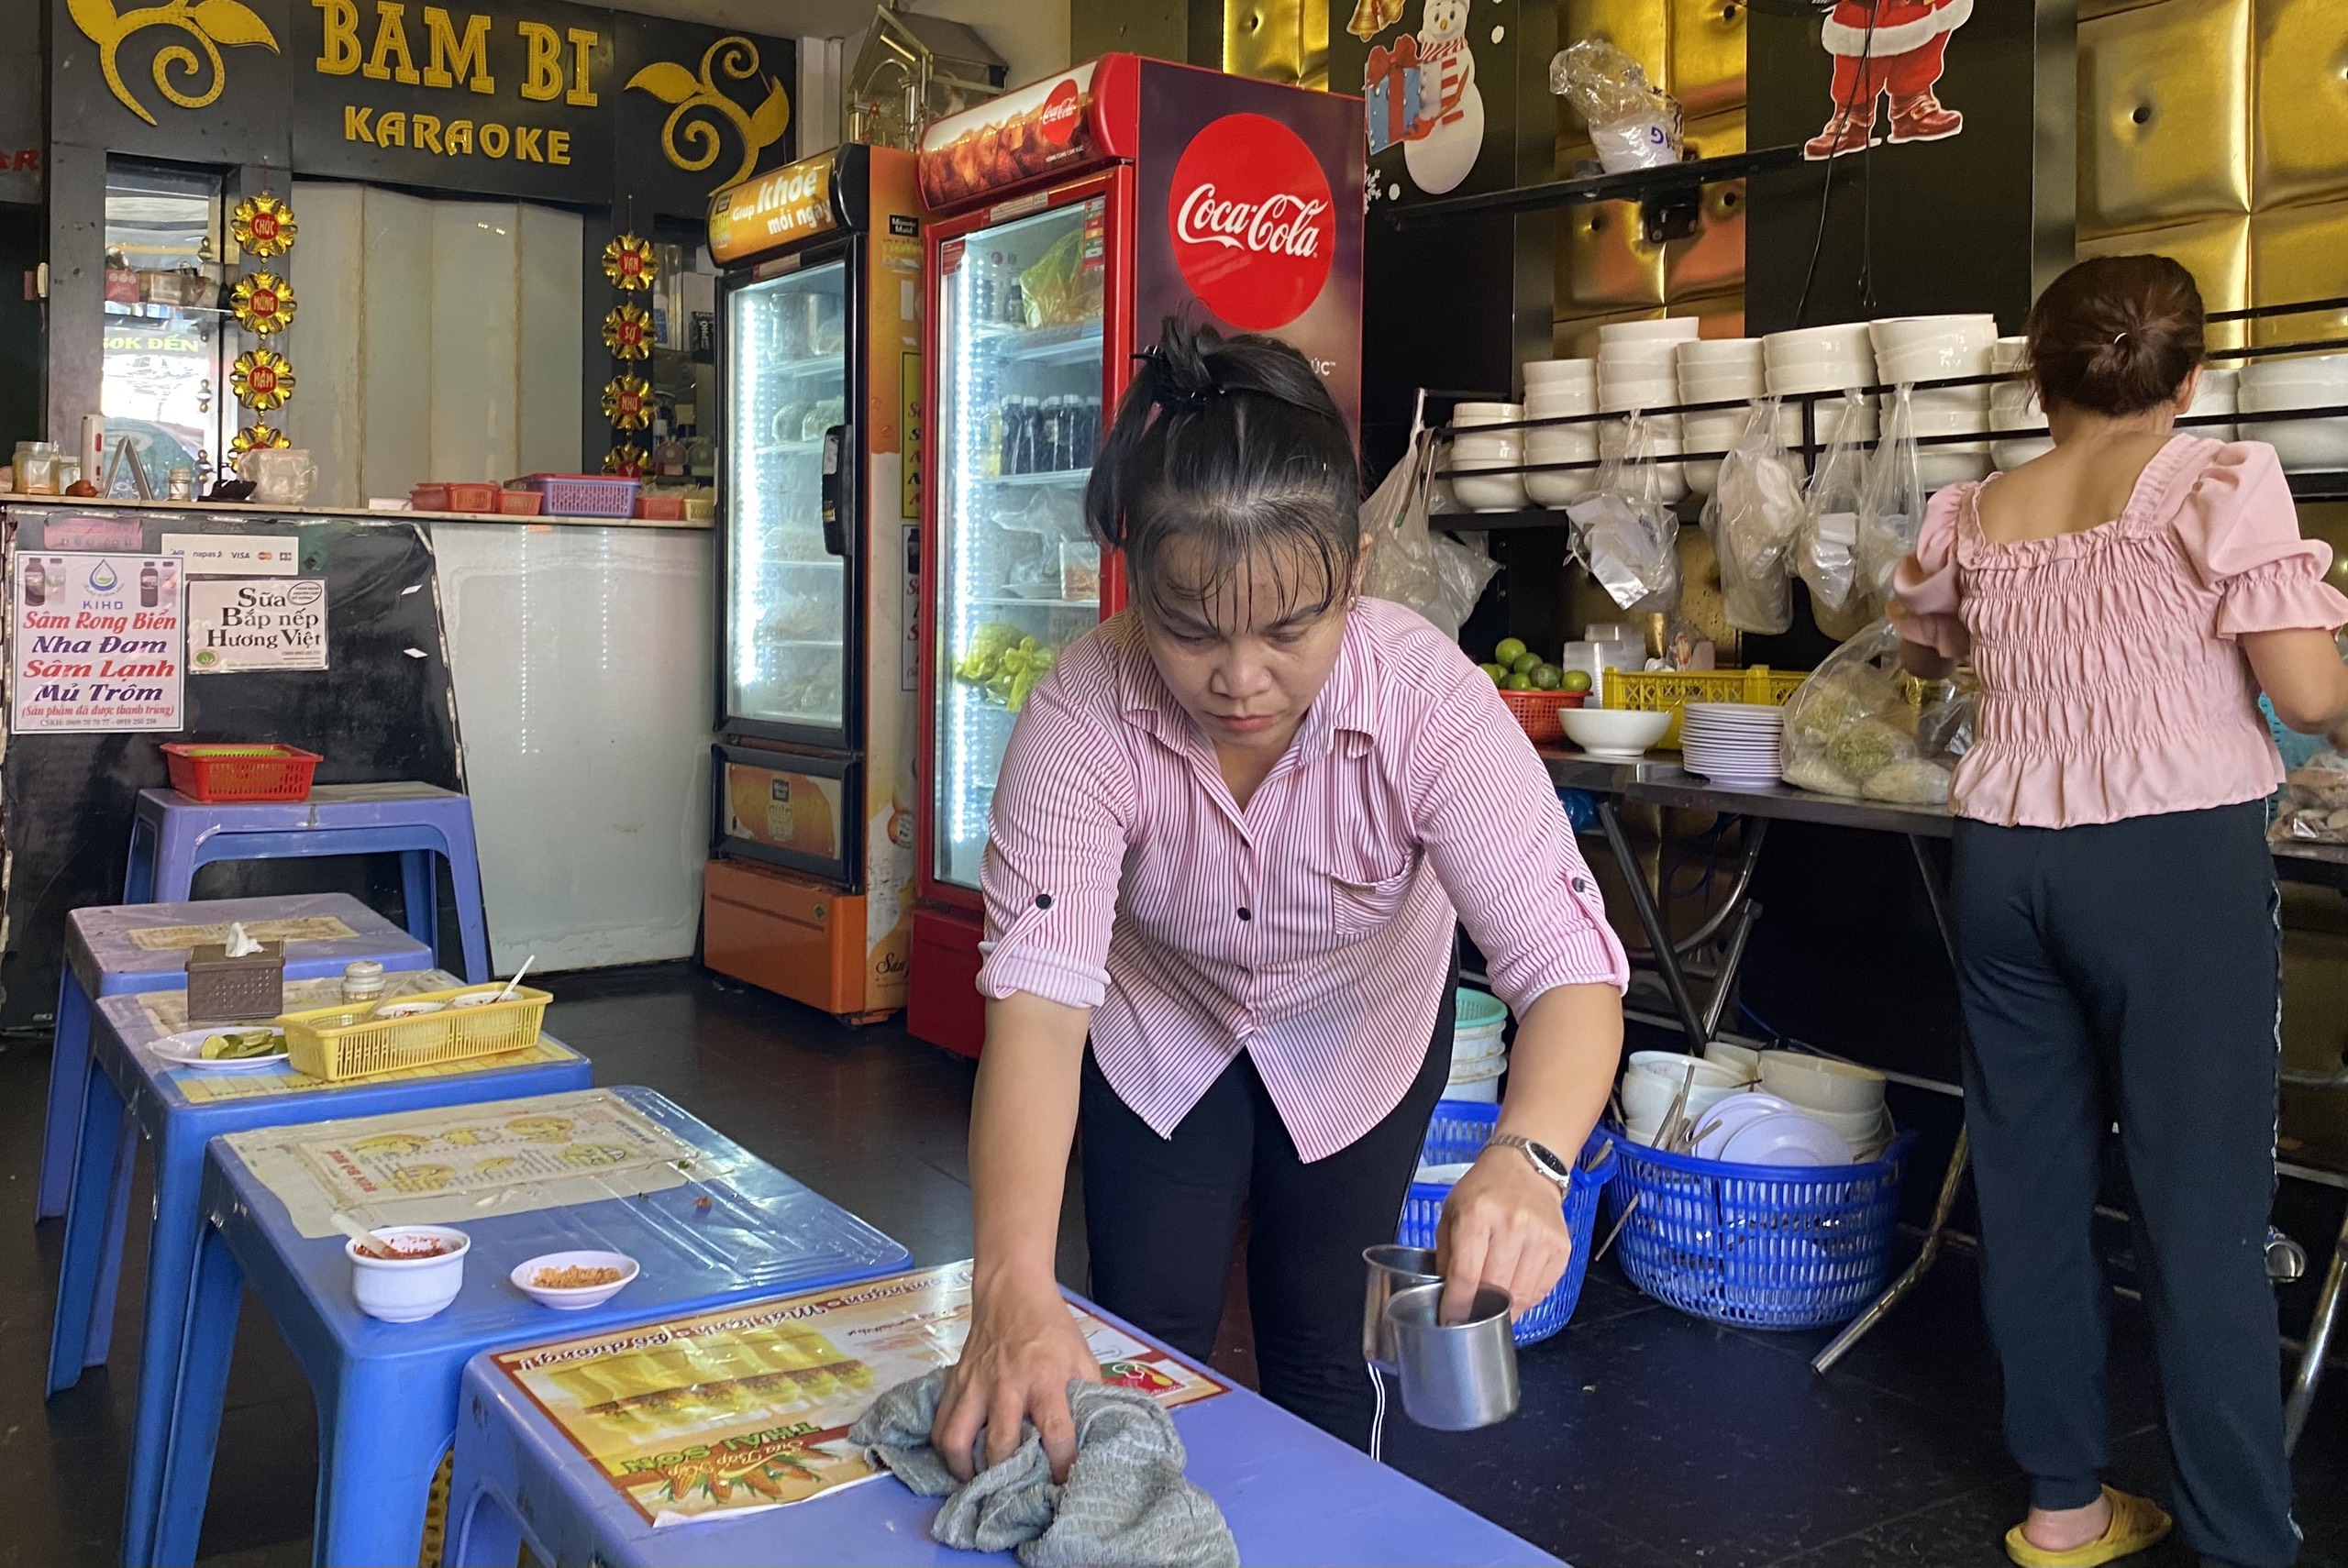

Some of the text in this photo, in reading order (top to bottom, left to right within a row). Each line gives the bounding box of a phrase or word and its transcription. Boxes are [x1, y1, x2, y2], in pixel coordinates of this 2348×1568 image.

[312, 0, 598, 106] BAM BI
[1042, 96, 1079, 125] Coca-Cola
[344, 105, 571, 165] KARAOKE
[254, 216, 275, 237] CHÚC
[1178, 183, 1329, 258] Coca-Cola
[145, 333, 199, 352] ĐẾN
[83, 601, 124, 611] KIHO
[238, 587, 286, 608] Sữa
[23, 609, 177, 635] Sâm Rong Biển
[221, 606, 319, 629] Bắp nếp
[32, 635, 168, 654] Nha Đam
[207, 628, 322, 649] Hương Việt
[23, 659, 175, 682] Sâm Lạnh
[34, 682, 163, 702] Mủ Trôm
[116, 704, 144, 716] thanh
